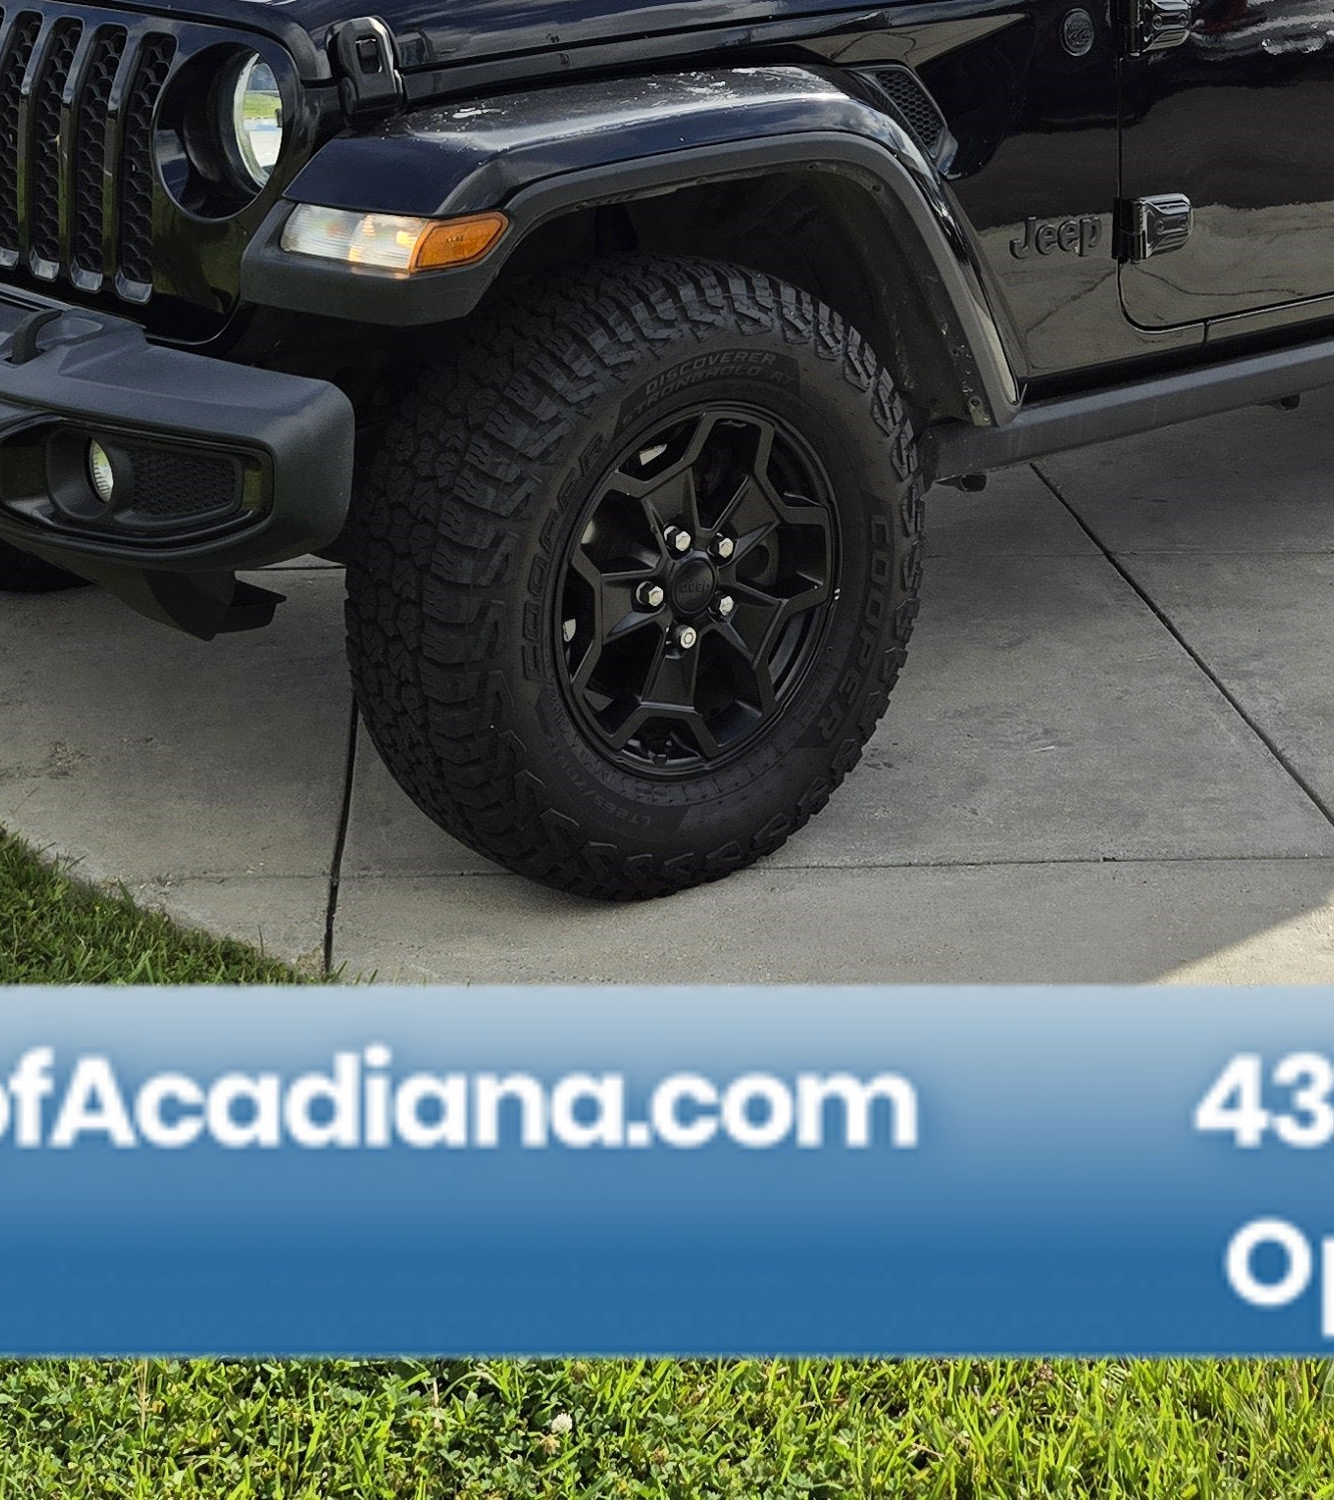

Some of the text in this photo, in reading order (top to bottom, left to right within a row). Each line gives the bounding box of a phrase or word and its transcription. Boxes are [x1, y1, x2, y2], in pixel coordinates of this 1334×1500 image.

[1009, 216, 1103, 260] Jeep
[645, 351, 777, 397] DISCOVERER
[521, 430, 606, 681] COOPER
[817, 513, 892, 741] COOPER
